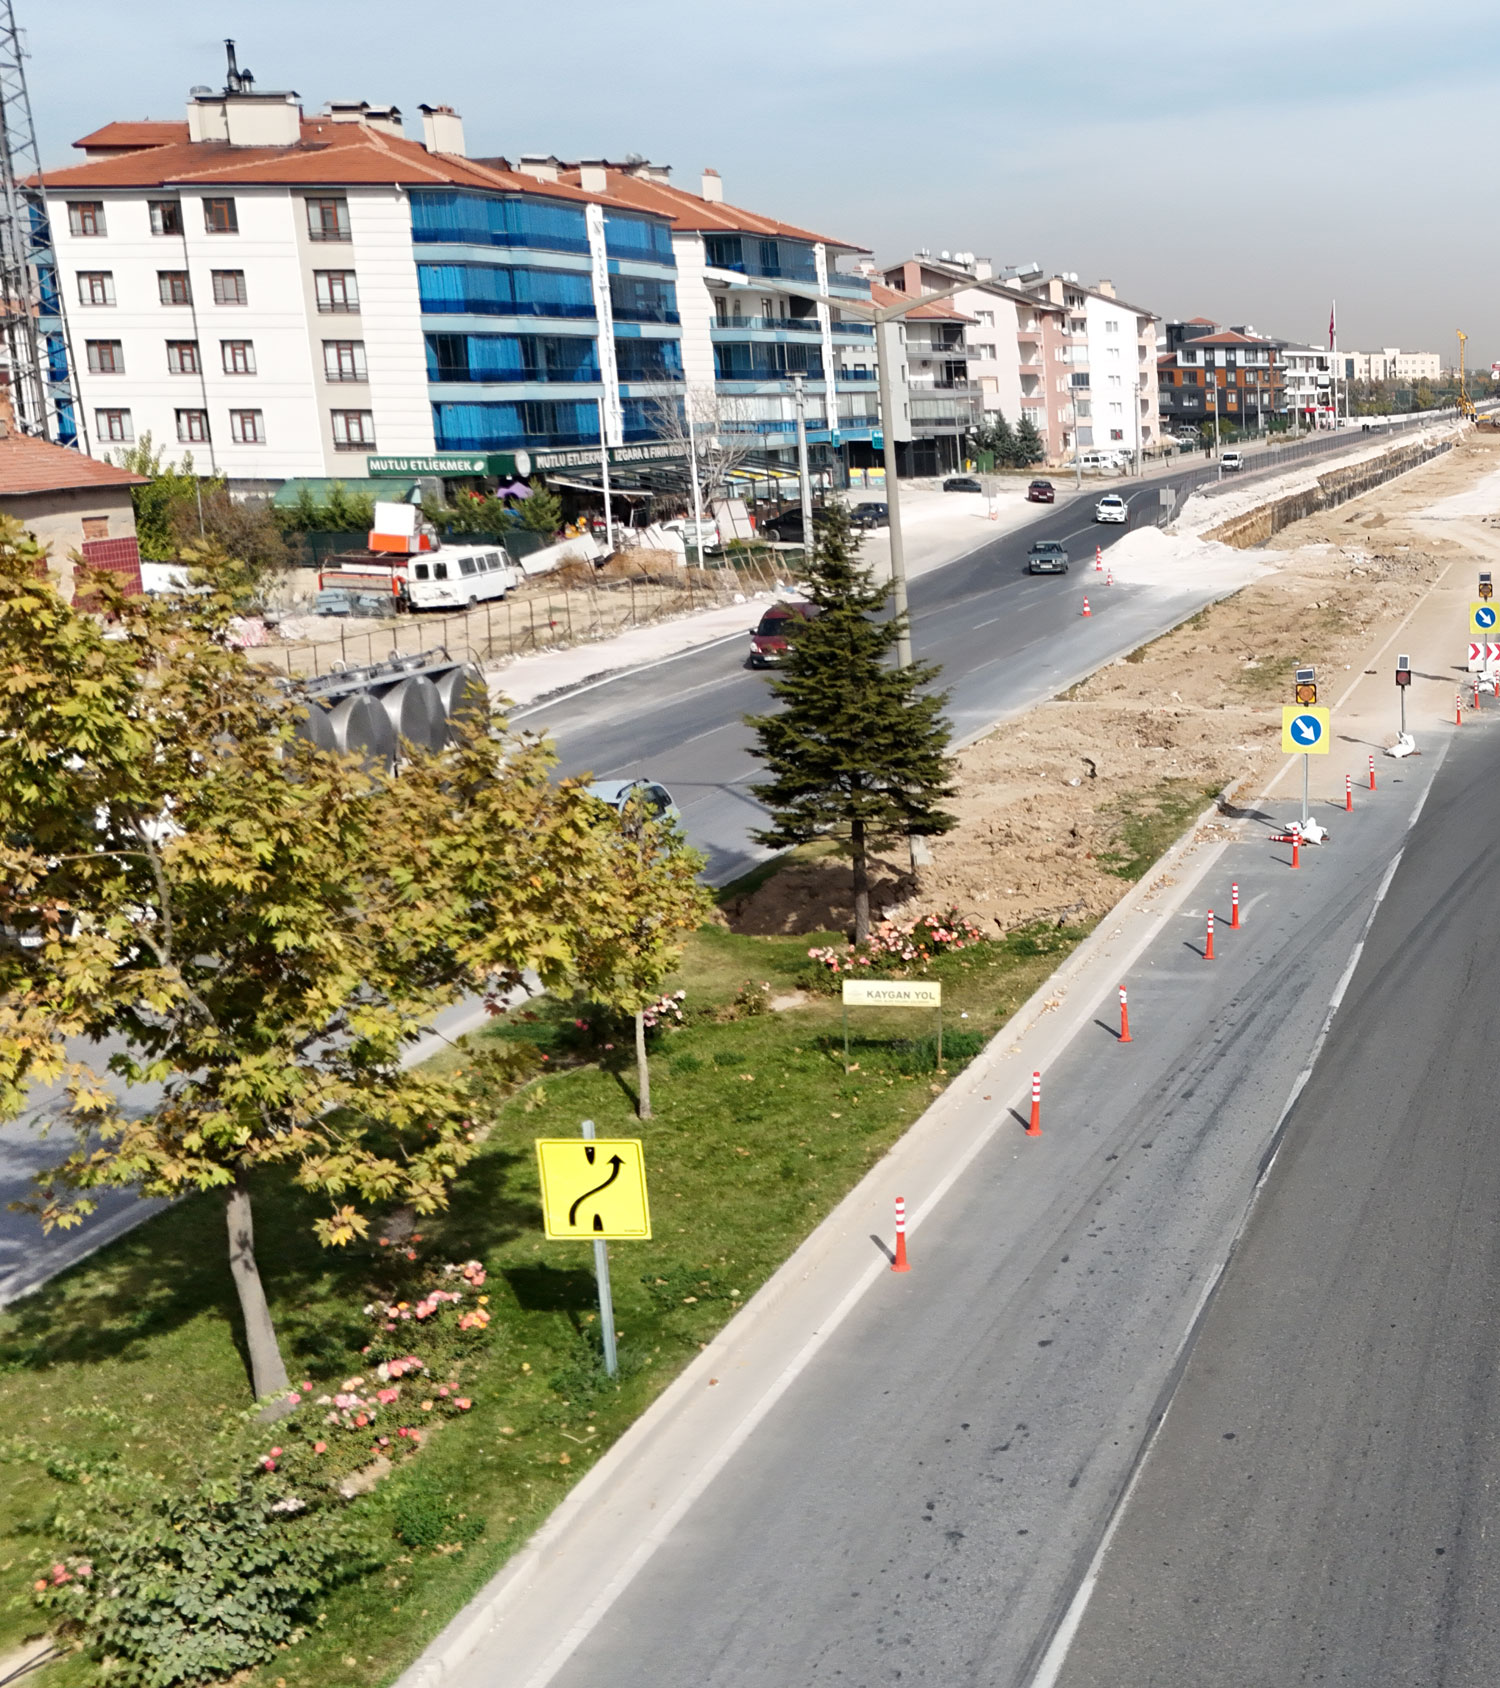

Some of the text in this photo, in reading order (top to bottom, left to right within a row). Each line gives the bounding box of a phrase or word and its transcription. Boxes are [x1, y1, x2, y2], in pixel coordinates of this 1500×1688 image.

[369, 457, 472, 472] MUTLU ETLİEKMEK
[536, 453, 567, 469] MUTLU
[614, 448, 642, 462] IZGARA
[866, 990, 935, 1000] KAYGAN YOL
